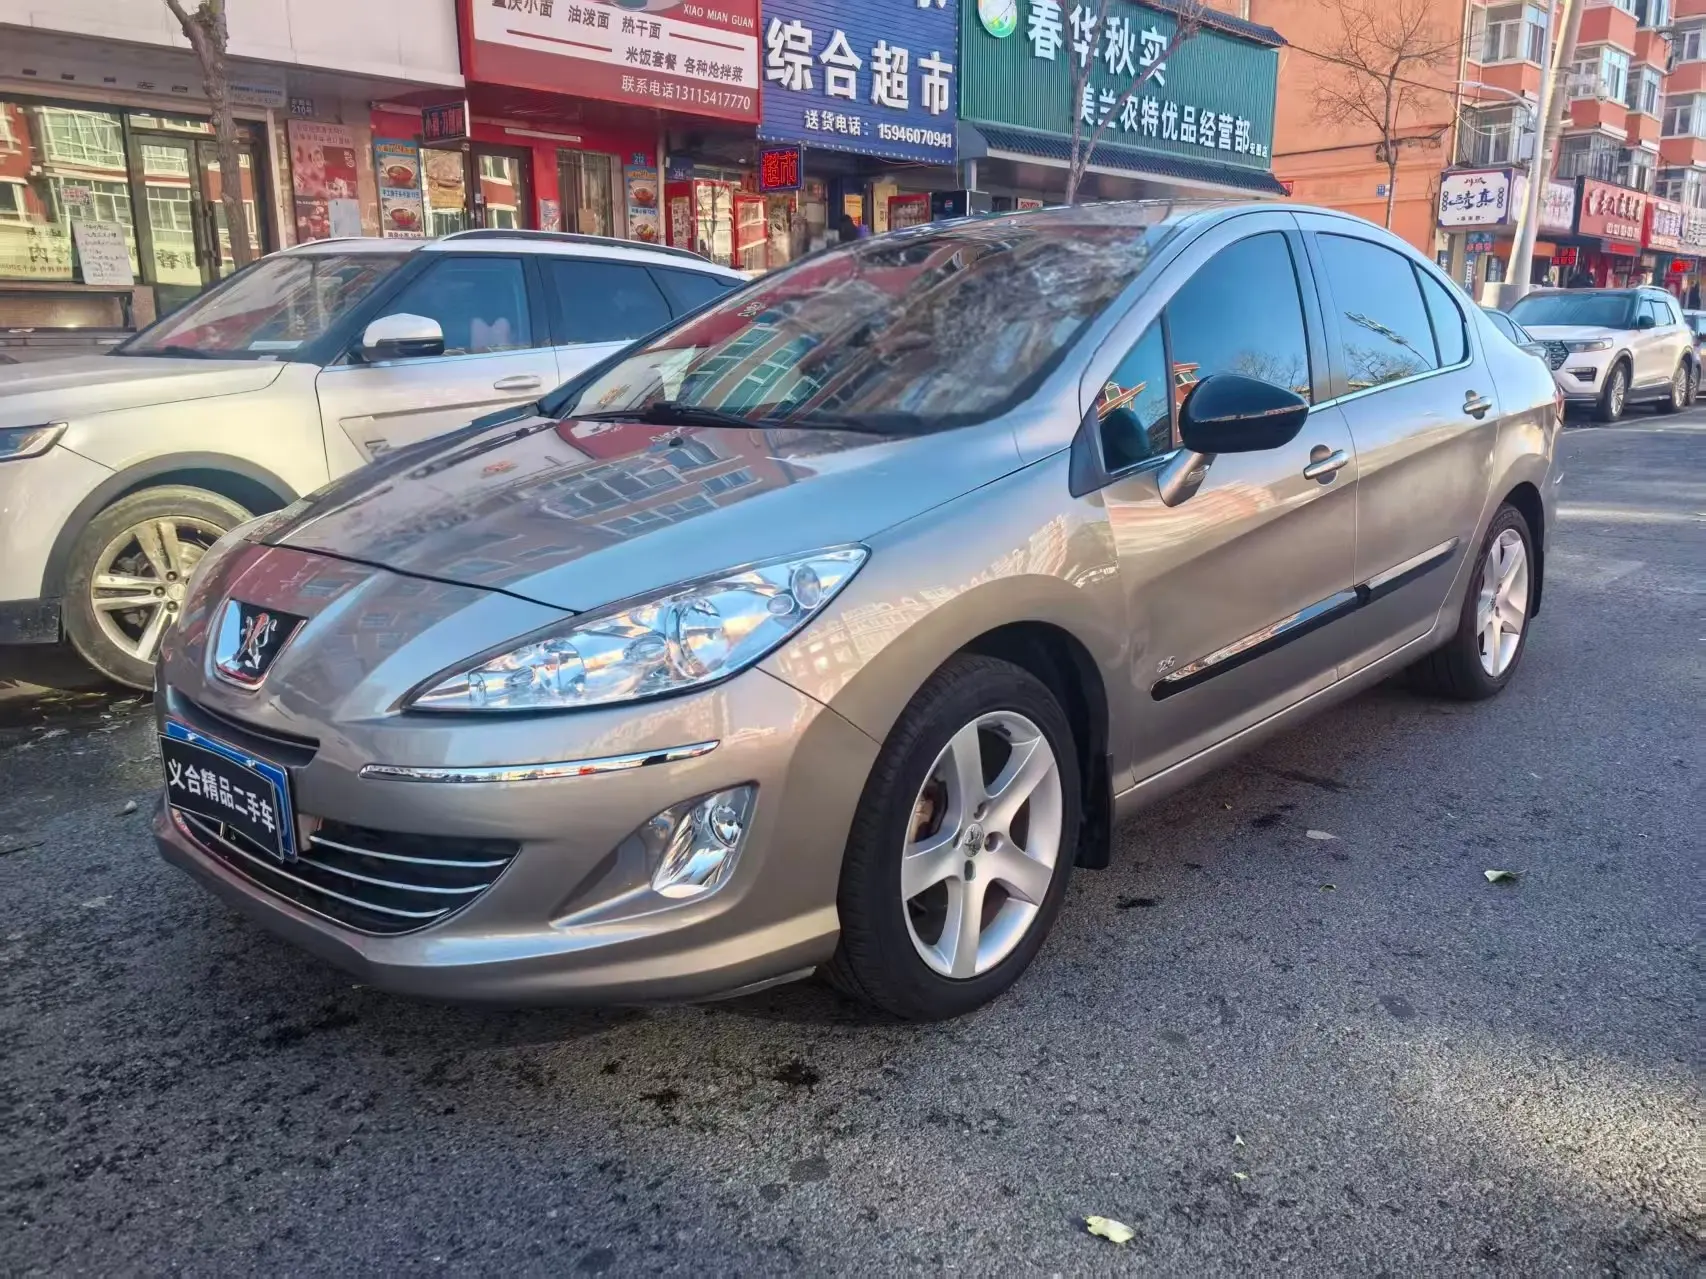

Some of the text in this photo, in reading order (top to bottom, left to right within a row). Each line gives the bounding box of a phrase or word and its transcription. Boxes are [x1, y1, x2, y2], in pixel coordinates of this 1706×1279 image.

[567, 5, 610, 29] 油泼面
[622, 16, 661, 39] 热干面
[684, 4, 754, 28] XIAO MIAN GUAN
[626, 46, 677, 71] 米饭套餐
[1028, 0, 1167, 86] 春华秋实
[766, 17, 954, 115] 综合超市
[621, 75, 751, 110] 联系电话13115417770
[878, 123, 952, 148] 15946070941
[1080, 82, 1250, 154] 美兰农特优品经营部
[763, 152, 798, 187] 超市
[168, 758, 276, 833] 义合精品二手车
